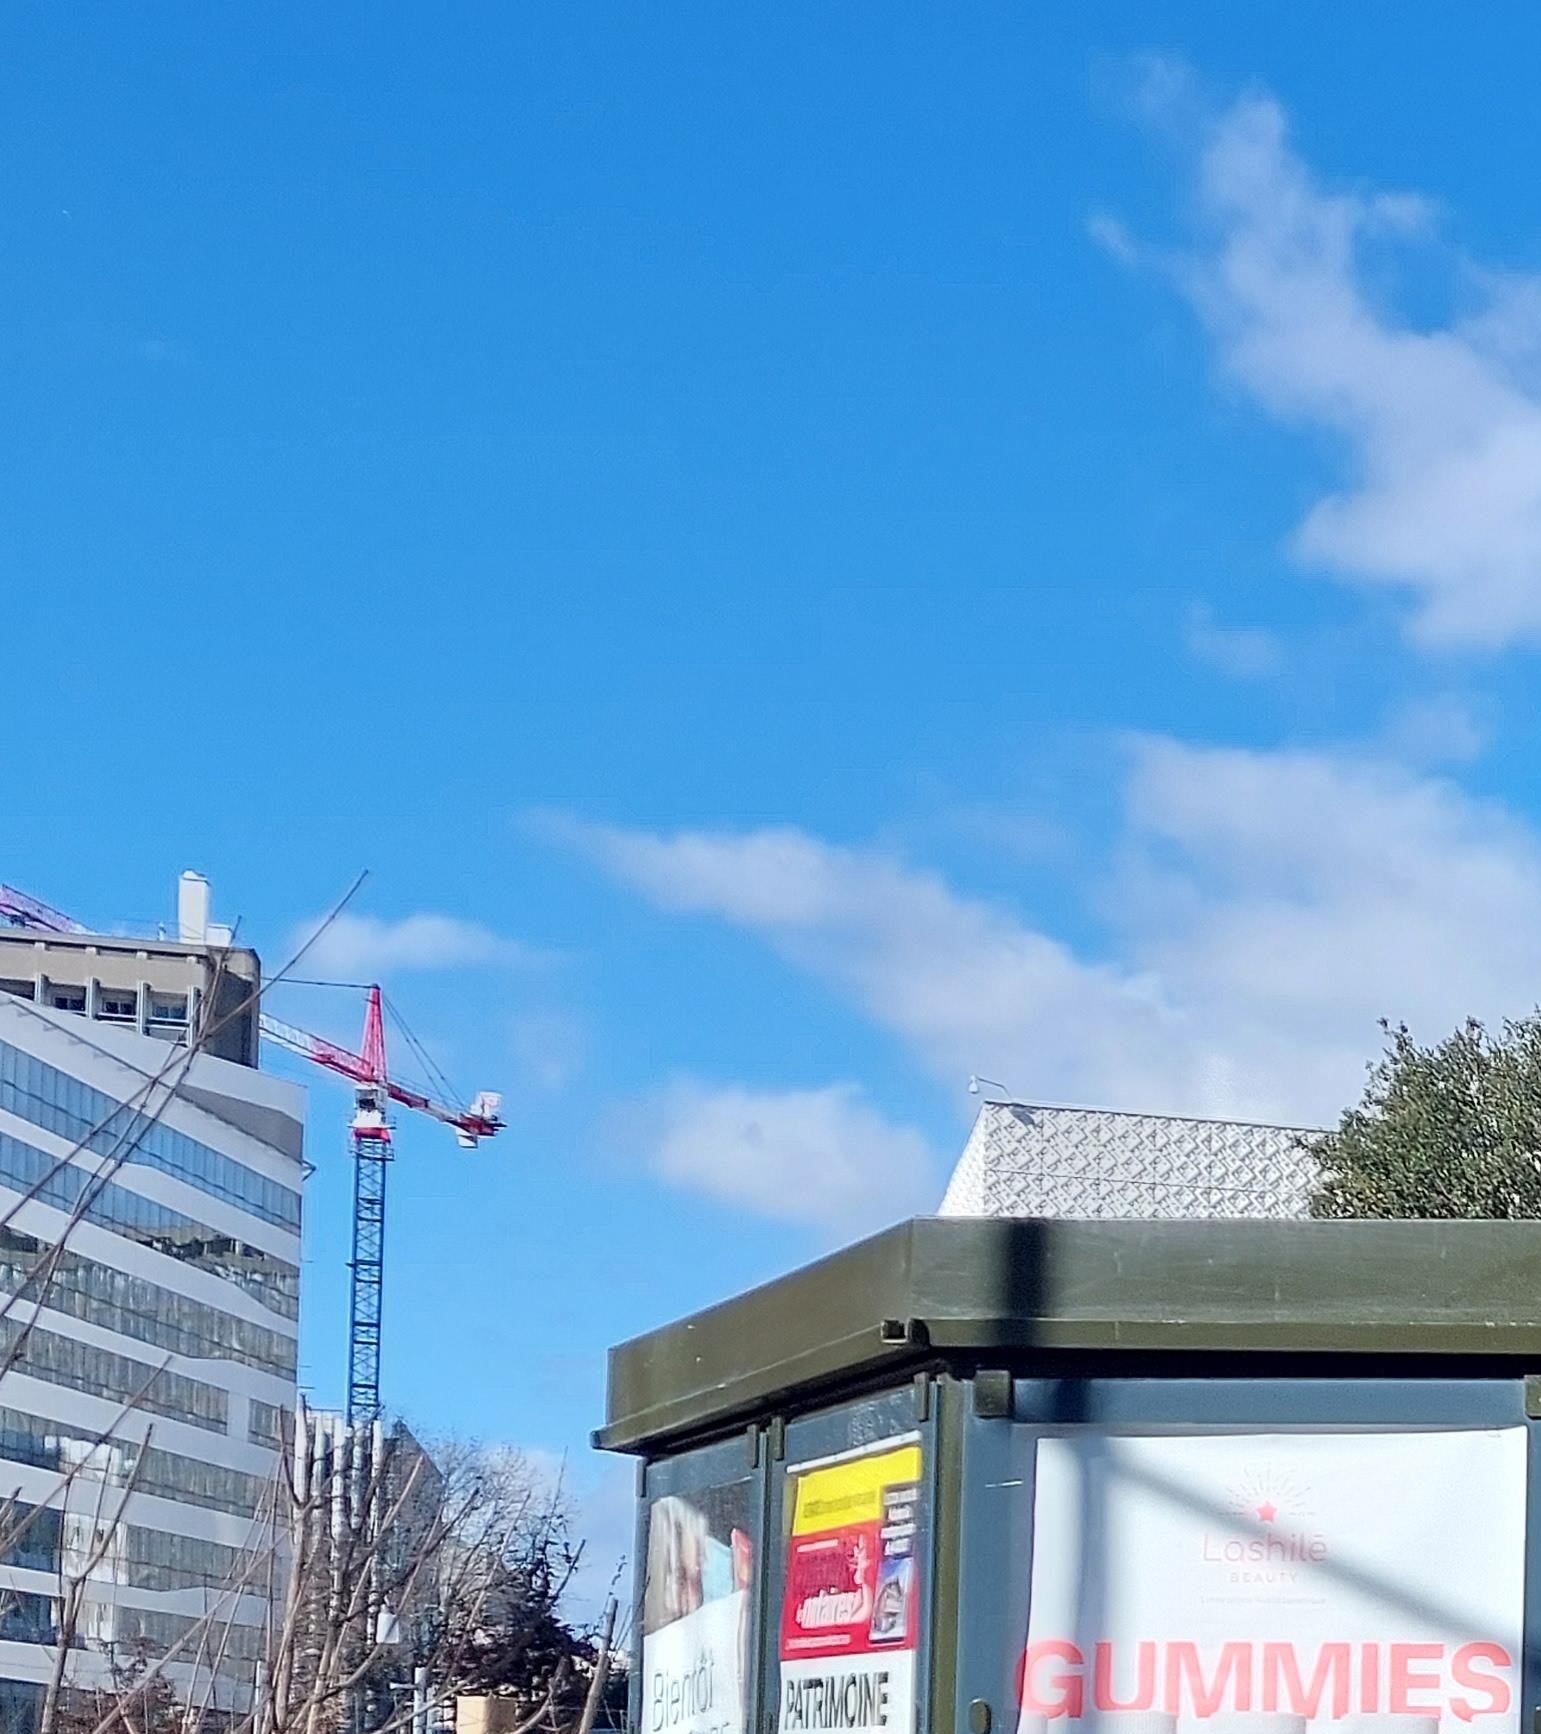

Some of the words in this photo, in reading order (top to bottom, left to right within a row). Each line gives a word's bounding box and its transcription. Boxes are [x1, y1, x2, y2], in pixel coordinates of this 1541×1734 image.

[652, 1652, 715, 1732] Bientôt
[785, 1671, 889, 1731] PATRIMOINE
[1015, 1641, 1513, 1721] GUMMIES
